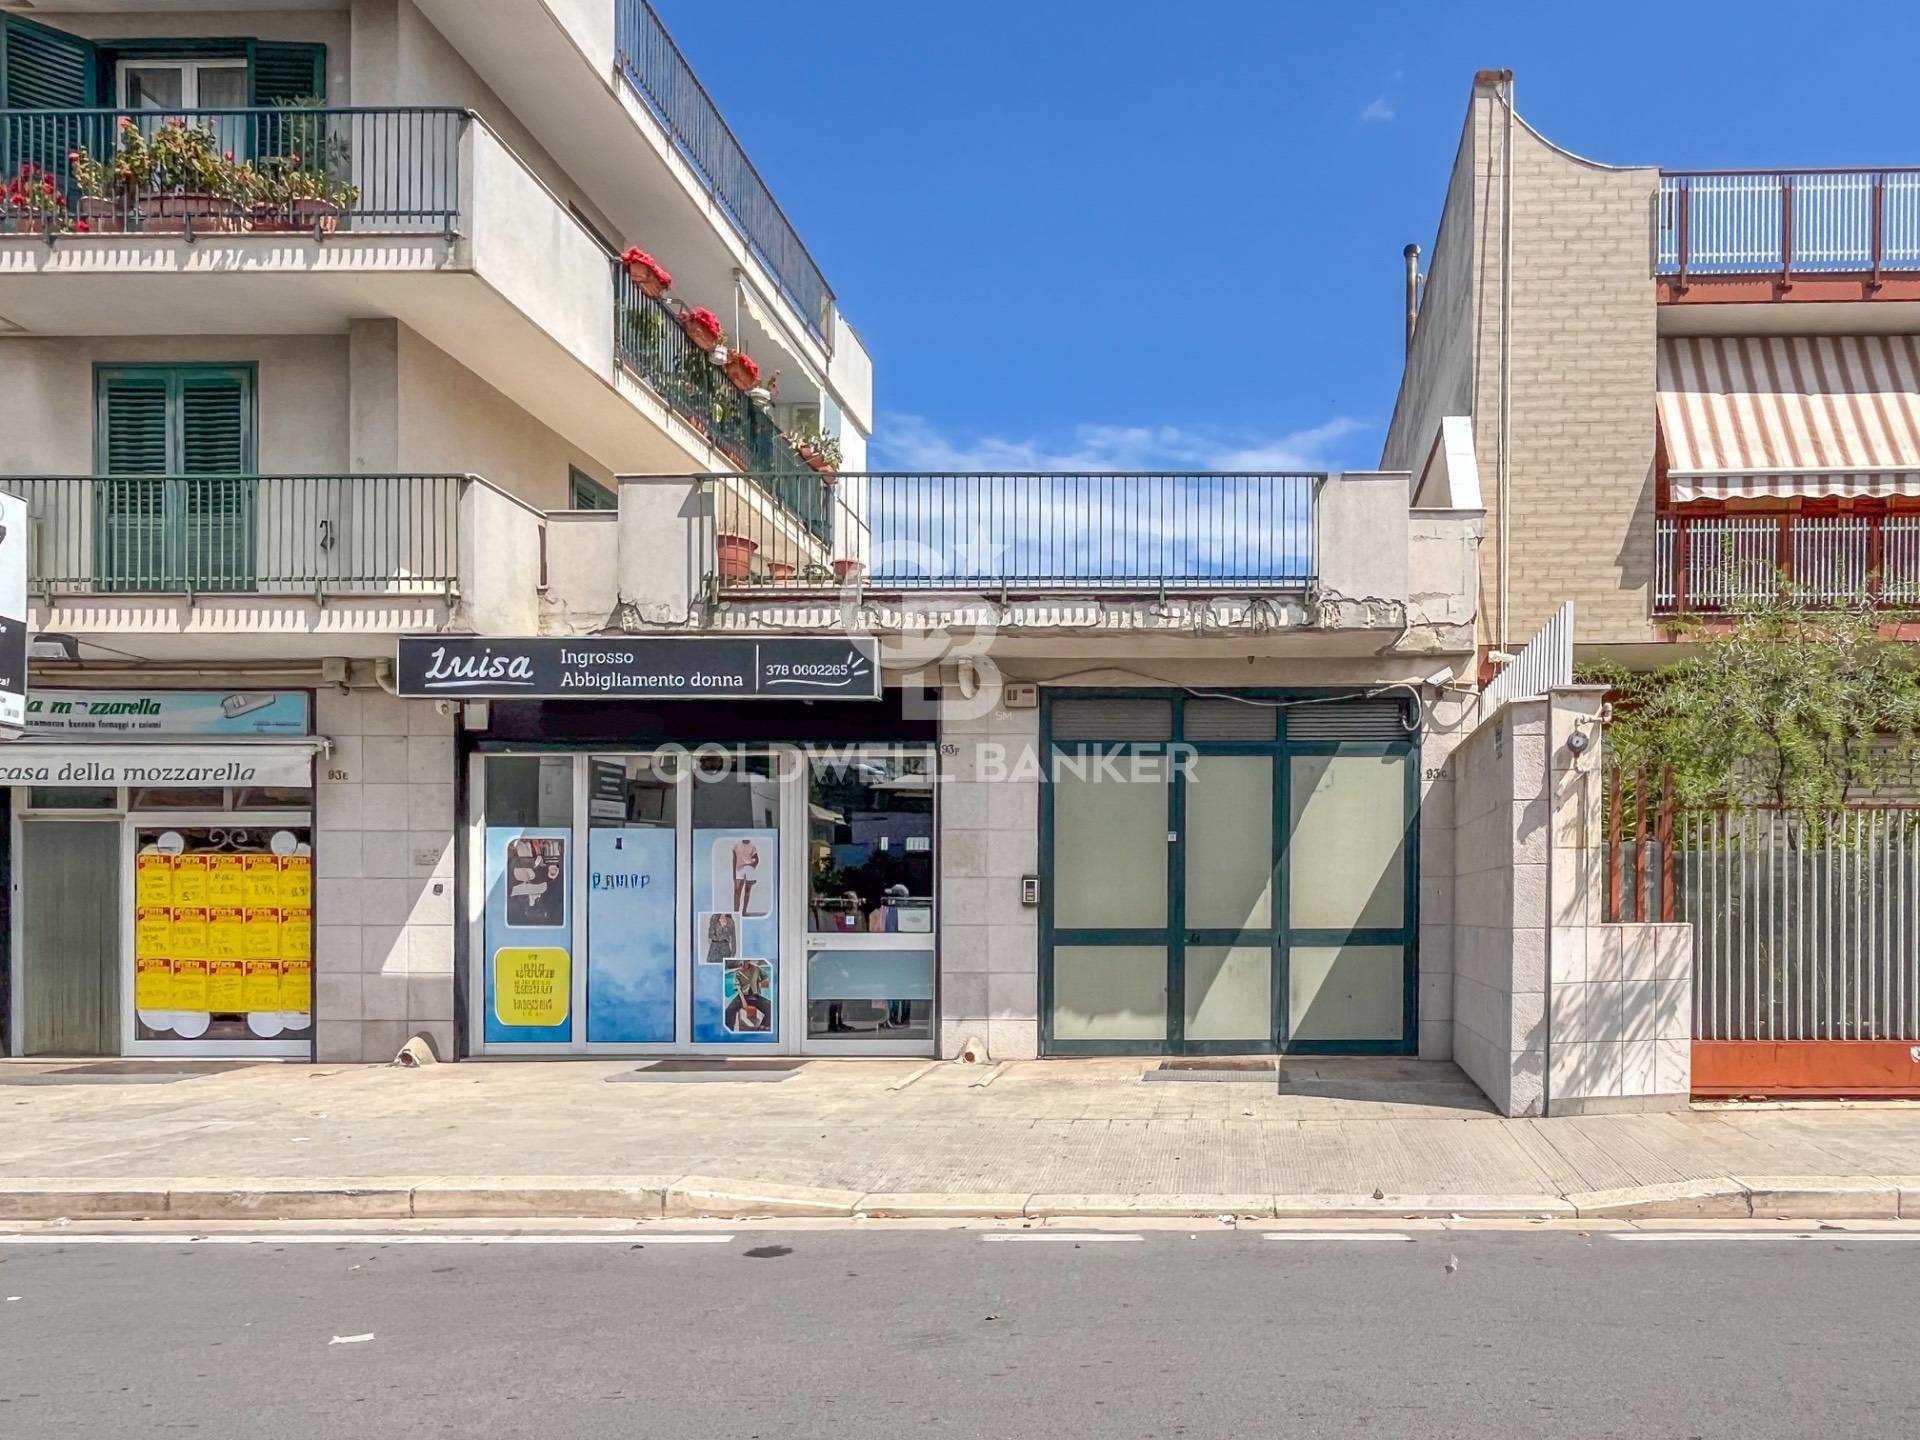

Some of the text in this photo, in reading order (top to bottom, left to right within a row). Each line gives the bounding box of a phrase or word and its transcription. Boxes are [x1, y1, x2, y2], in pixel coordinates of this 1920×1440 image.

[425, 646, 534, 679] Luisa
[560, 649, 634, 668] Ingrosso
[766, 665, 848, 676] 378 0602265
[560, 672, 744, 690] Abbigliamento donna
[26, 699, 43, 713] a
[0, 762, 256, 781] casa della mozzarella
